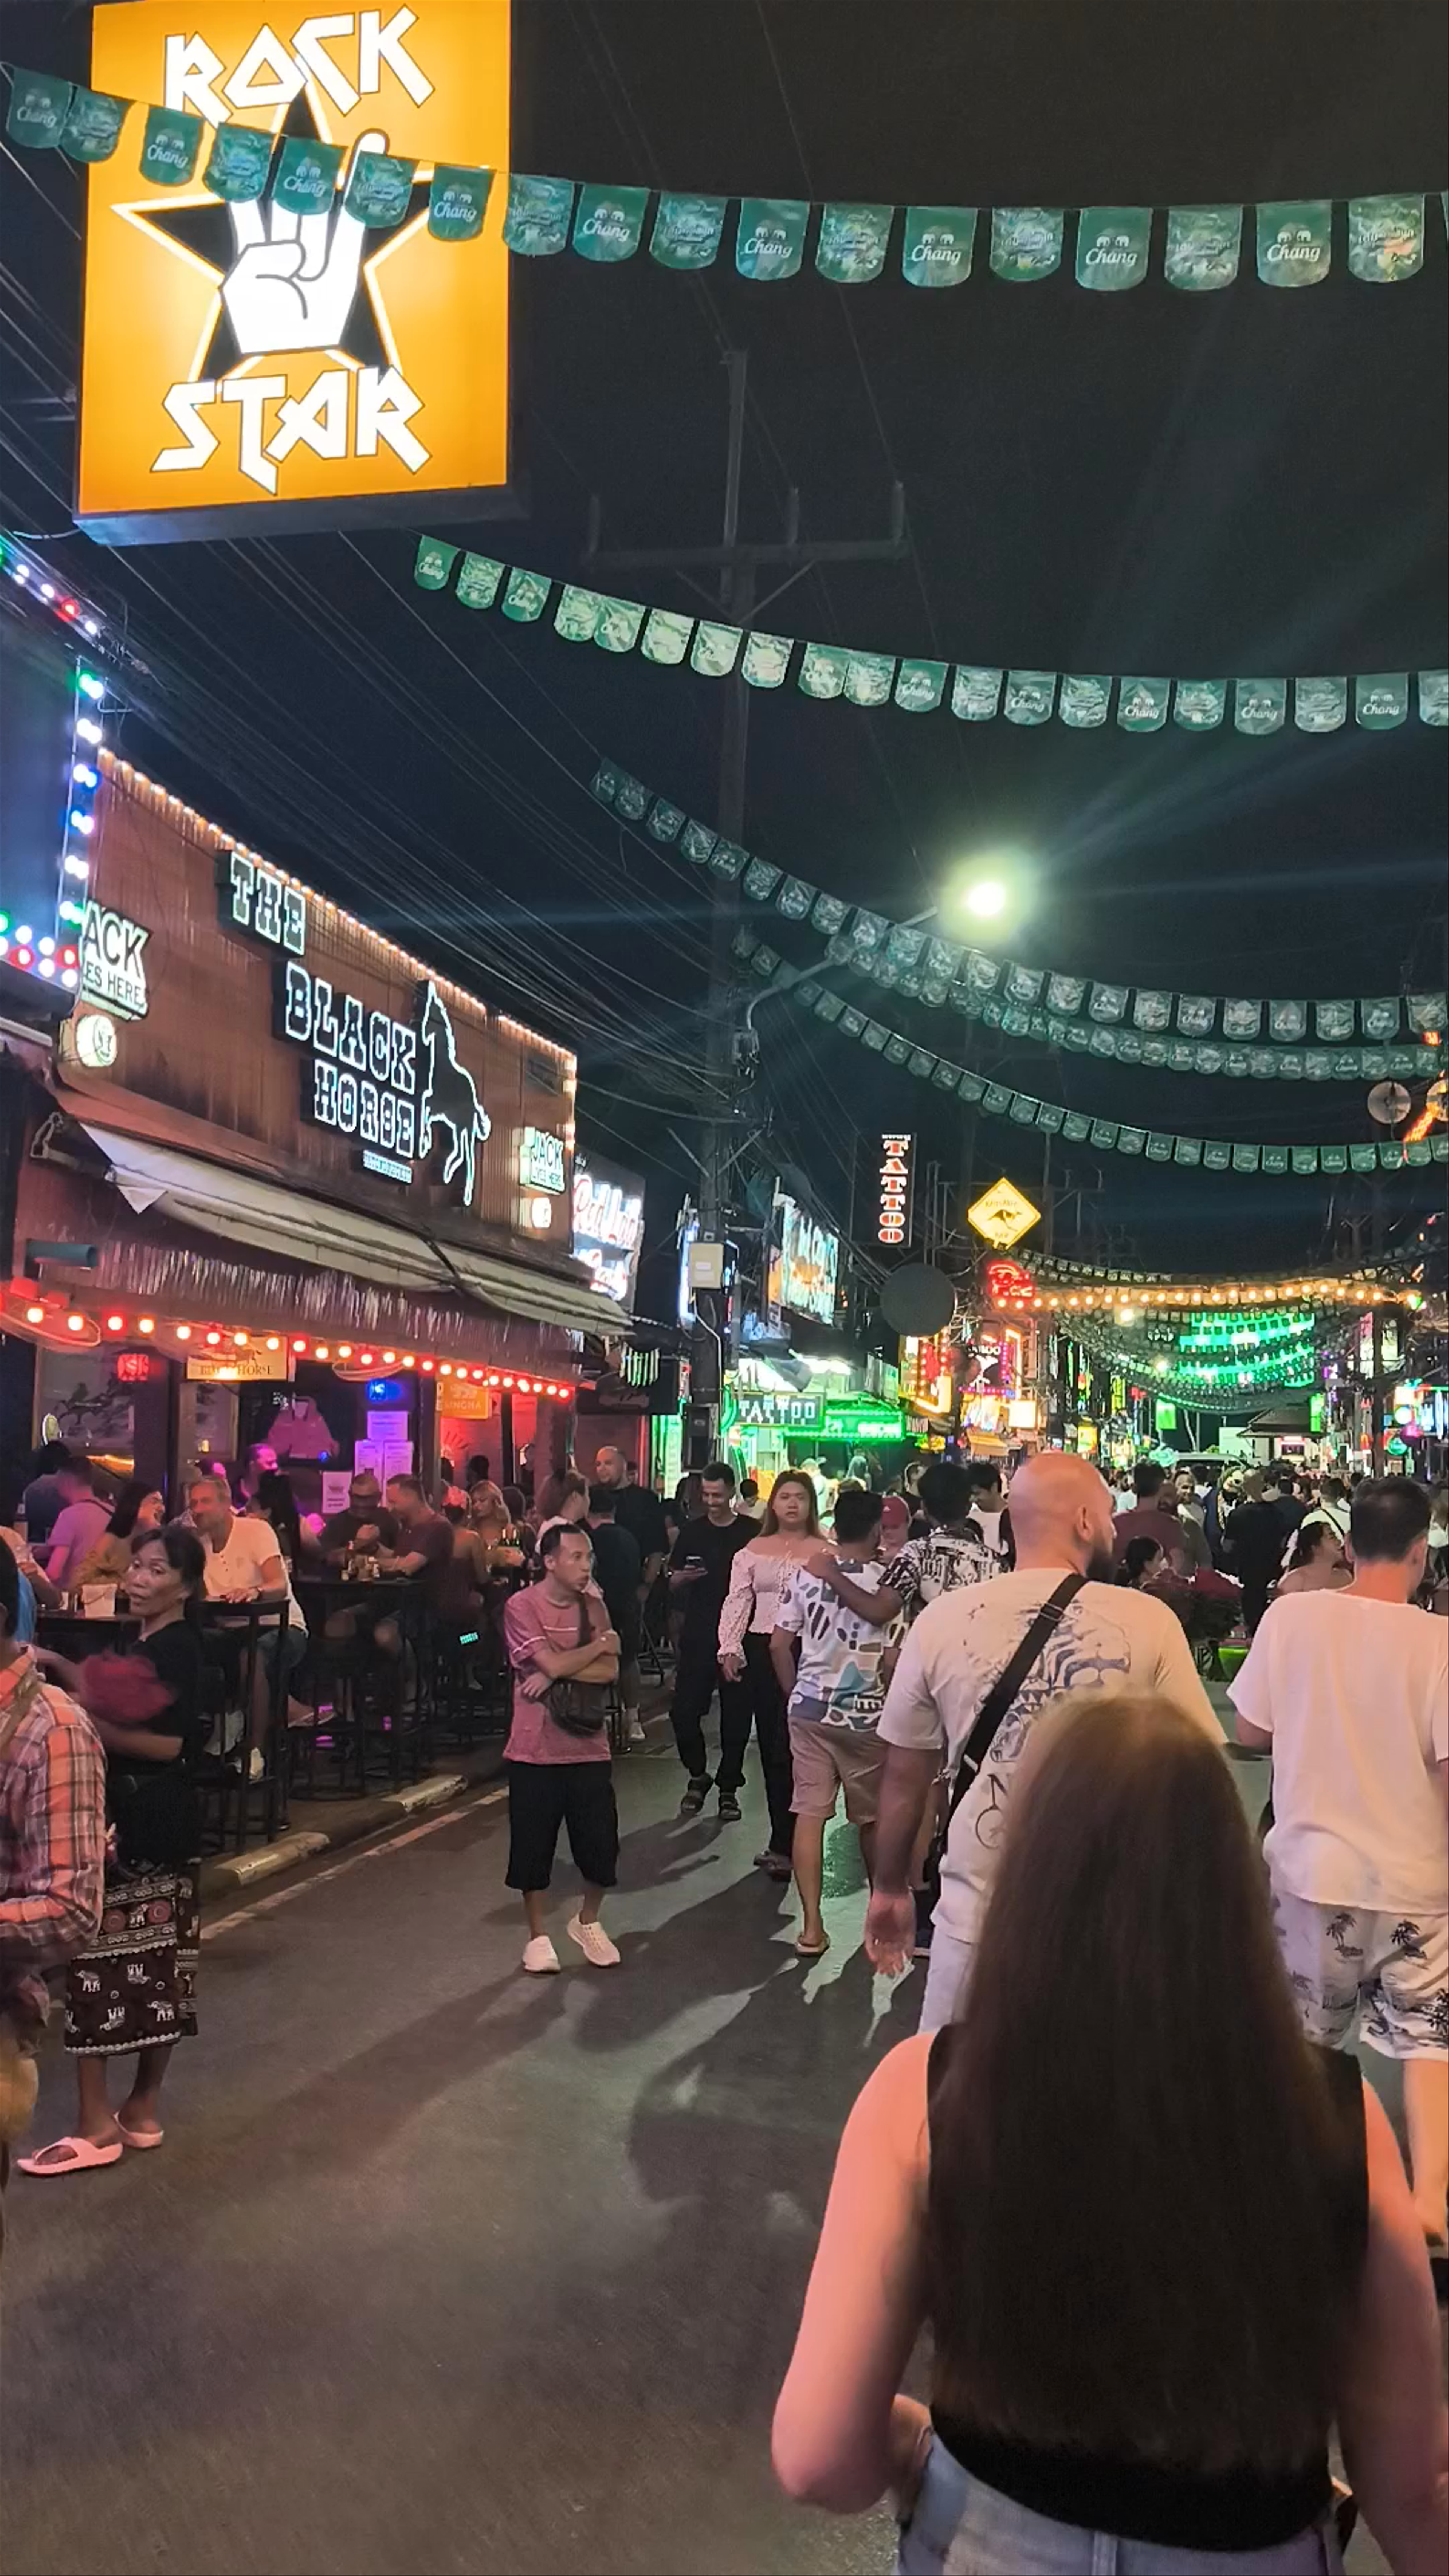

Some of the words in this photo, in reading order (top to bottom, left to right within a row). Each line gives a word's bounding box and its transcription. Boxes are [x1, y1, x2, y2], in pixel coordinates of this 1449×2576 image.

[164, 3, 435, 130] ROCK
[16, 106, 57, 129] Chang
[147, 144, 188, 169] Chang
[283, 176, 327, 198] Chang
[433, 201, 478, 223] Chang
[582, 218, 632, 242] Chang
[744, 237, 793, 259] Chang
[911, 244, 962, 265] Chang
[1085, 248, 1138, 267] Chang
[1266, 244, 1321, 262] Chang
[151, 364, 433, 496] STAR
[1010, 697, 1046, 712] Chang
[1124, 706, 1160, 720] Chang
[1241, 707, 1278, 720] Chang
[1362, 704, 1401, 716] Chang
[230, 851, 306, 955] THE
[83, 902, 143, 980] ACK
[285, 961, 417, 1095] BLACK
[314, 1058, 414, 1158] HORSE
[878, 1139, 909, 1243] TATTOO
[238, 1364, 274, 1375] HORSE
[738, 1395, 816, 1424] TATTOO
